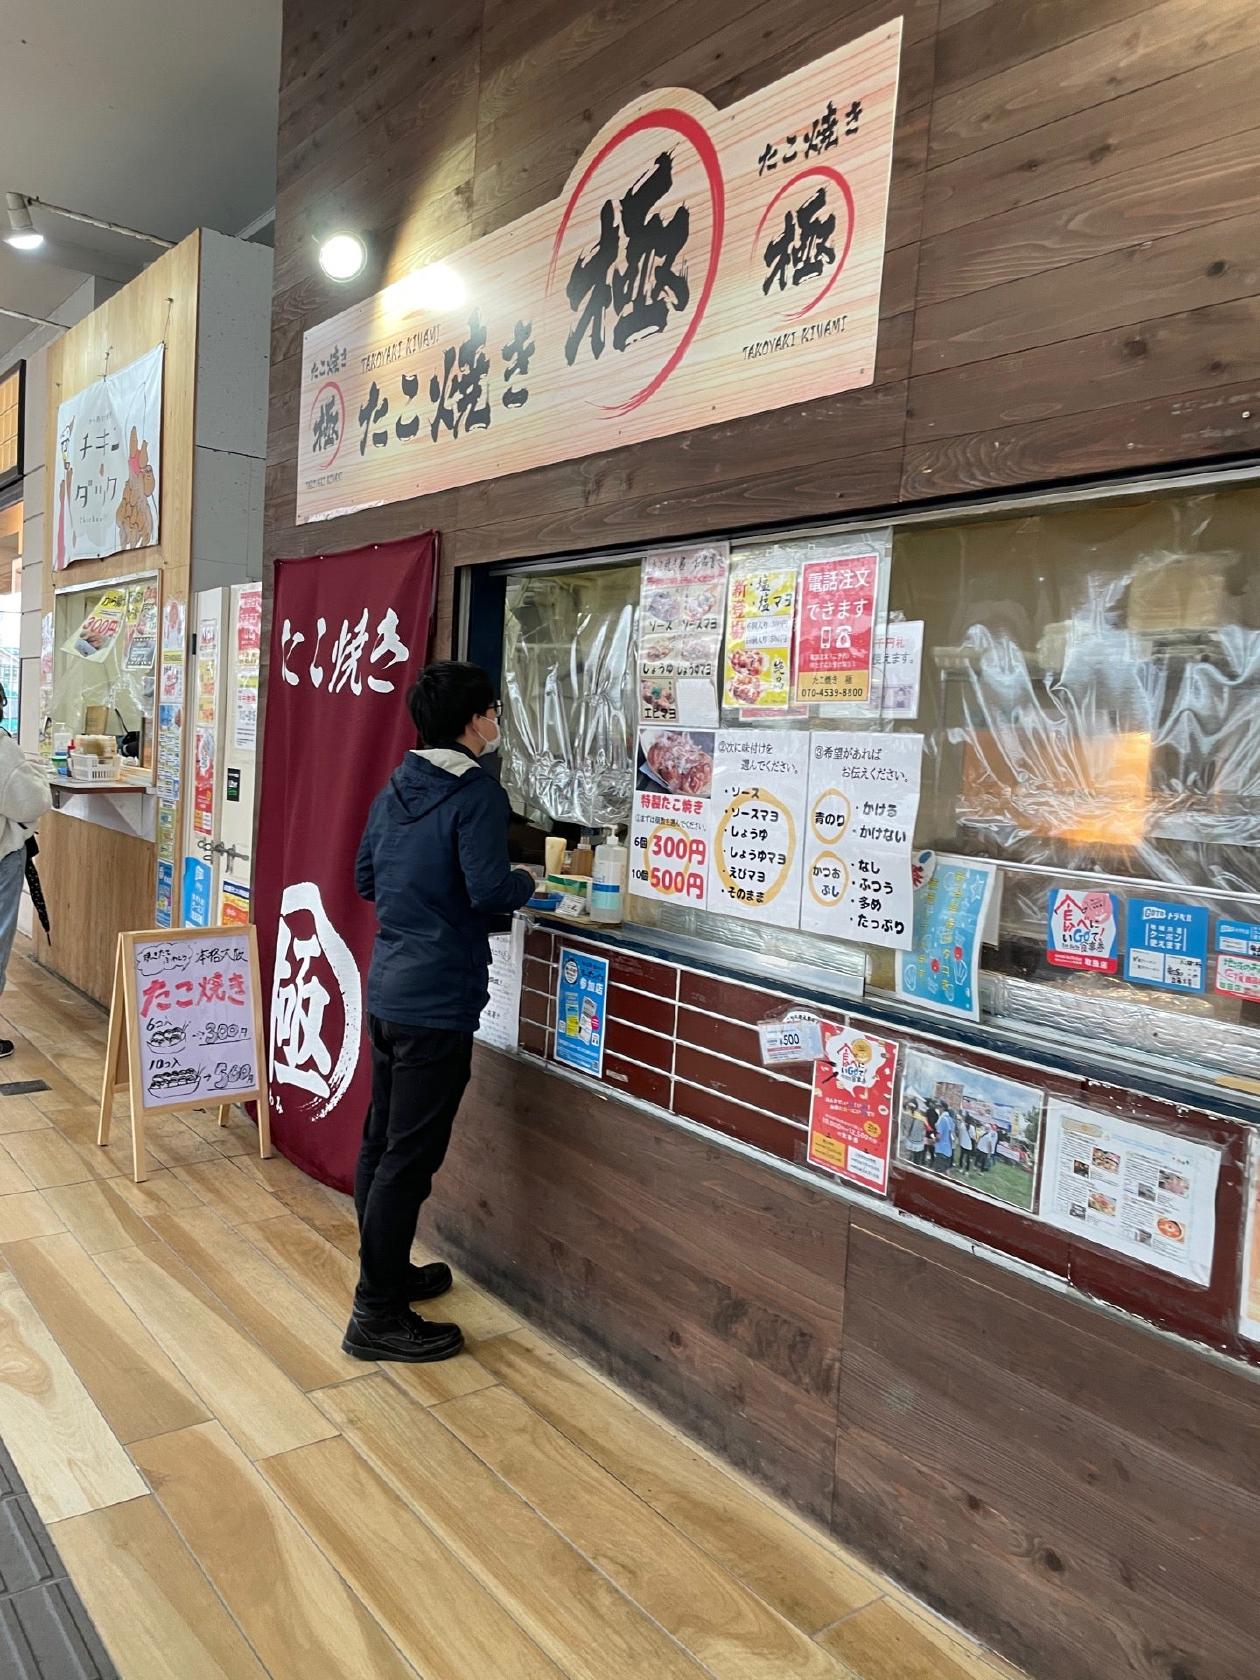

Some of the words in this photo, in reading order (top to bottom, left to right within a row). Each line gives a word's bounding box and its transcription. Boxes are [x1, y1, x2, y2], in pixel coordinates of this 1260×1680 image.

[758, 100, 862, 176] たこ焼き
[763, 182, 836, 296] 極
[565, 142, 690, 366] 極
[742, 332, 797, 361] TAKOYAKI
[311, 345, 347, 381] たこ焼き
[358, 307, 535, 457] たこ焼き
[312, 395, 339, 452] 極
[75, 476, 118, 509] ダック
[808, 569, 870, 592] 電話注文
[807, 598, 868, 621] できます
[649, 620, 672, 632] ソース
[682, 618, 717, 632] ソースマヨ
[281, 607, 410, 697] たこ焼き
[642, 664, 673, 676] しょうゆ
[718, 740, 773, 755] ②次に味付けを
[815, 745, 882, 761] ③希望があれば
[741, 759, 799, 775] 選んでください。
[841, 766, 909, 783] お伝えください。
[731, 787, 760, 799] ソース
[640, 793, 704, 815] 特製たこ焼き
[863, 801, 898, 818] かける
[731, 808, 779, 823] ソースマヨ
[815, 811, 845, 828] 青のり
[731, 826, 768, 841] しょうゆ
[859, 825, 907, 843] かけない
[634, 837, 648, 849] 6個
[652, 834, 707, 866] 300円
[730, 846, 786, 865] しょうゆマヨ
[729, 867, 766, 883] えびマヨ
[812, 865, 841, 880] かつお
[858, 859, 881, 875] なし
[632, 868, 649, 882] 10個
[650, 867, 704, 900] 500円
[859, 878, 894, 895] ふつう
[727, 886, 765, 903] そのまま
[859, 897, 882, 912] 多め
[857, 913, 905, 935] たっぷり
[140, 971, 246, 1018] たこ焼き
[204, 1022, 249, 1045] 300円
